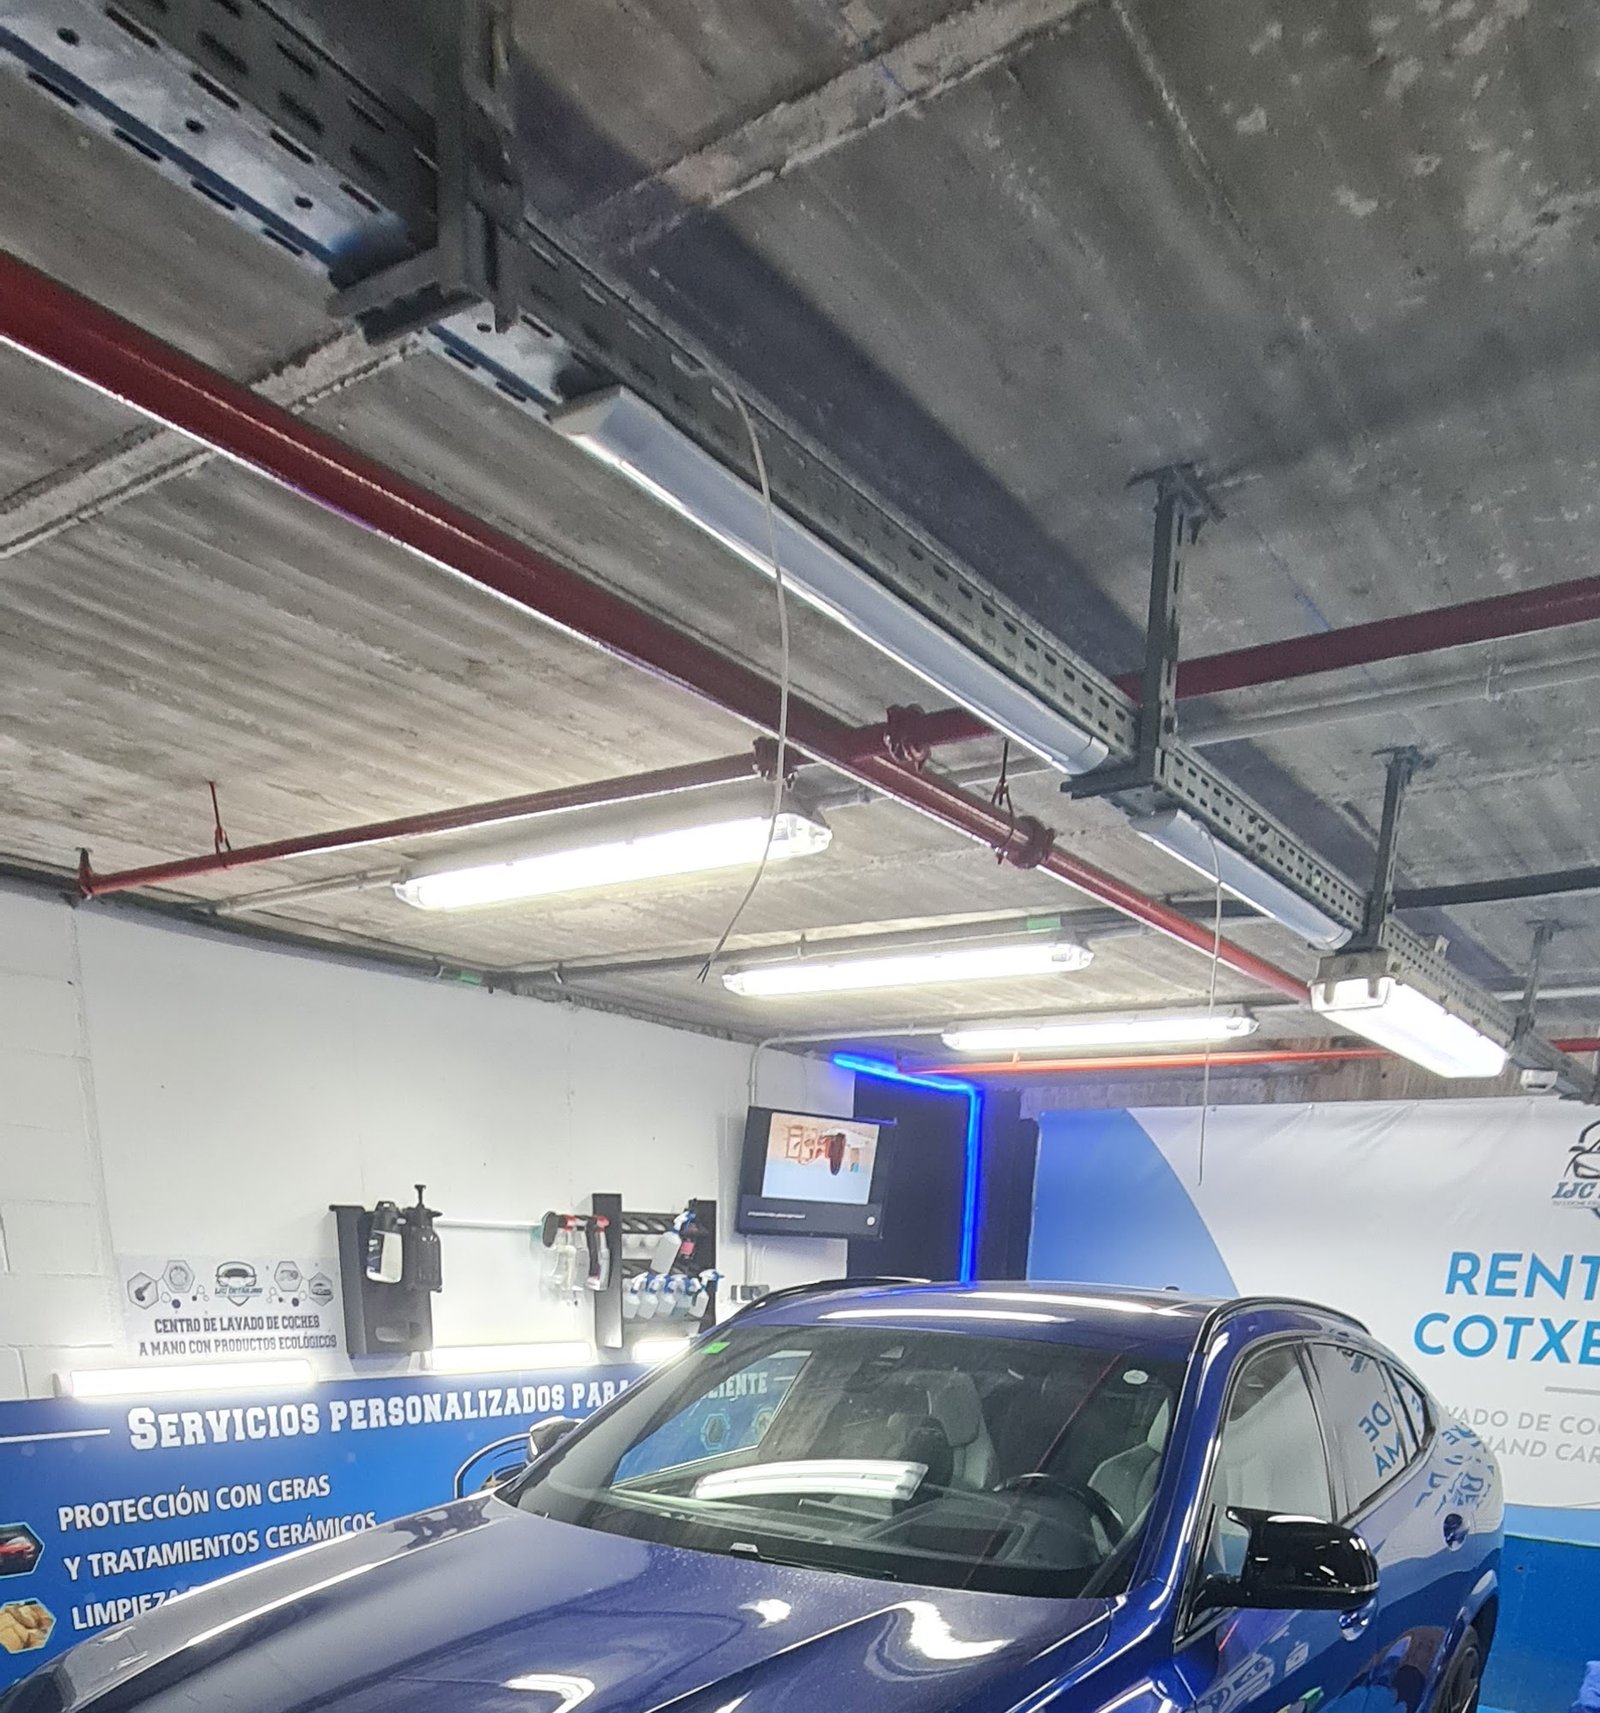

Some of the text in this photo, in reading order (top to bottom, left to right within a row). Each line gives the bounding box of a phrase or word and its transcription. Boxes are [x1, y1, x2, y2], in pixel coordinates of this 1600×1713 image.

[154, 1315, 320, 1334] CENTRO DE LAVADO DE COCHES
[139, 1341, 149, 1357] A
[150, 1340, 187, 1356] MANO
[190, 1339, 212, 1354] CON
[214, 1336, 277, 1353] PRODUCTOS
[127, 1402, 320, 1451] SERVICIOS
[330, 1384, 565, 1432] PERSONALIZADOS
[1518, 1412, 1552, 1432] DE
[1560, 1415, 1600, 1436] CO
[58, 1474, 331, 1532] PROTECCIÓN CON CERAS
[63, 1511, 377, 1581] Y TRATAMIENTOS CERÁMICOS
